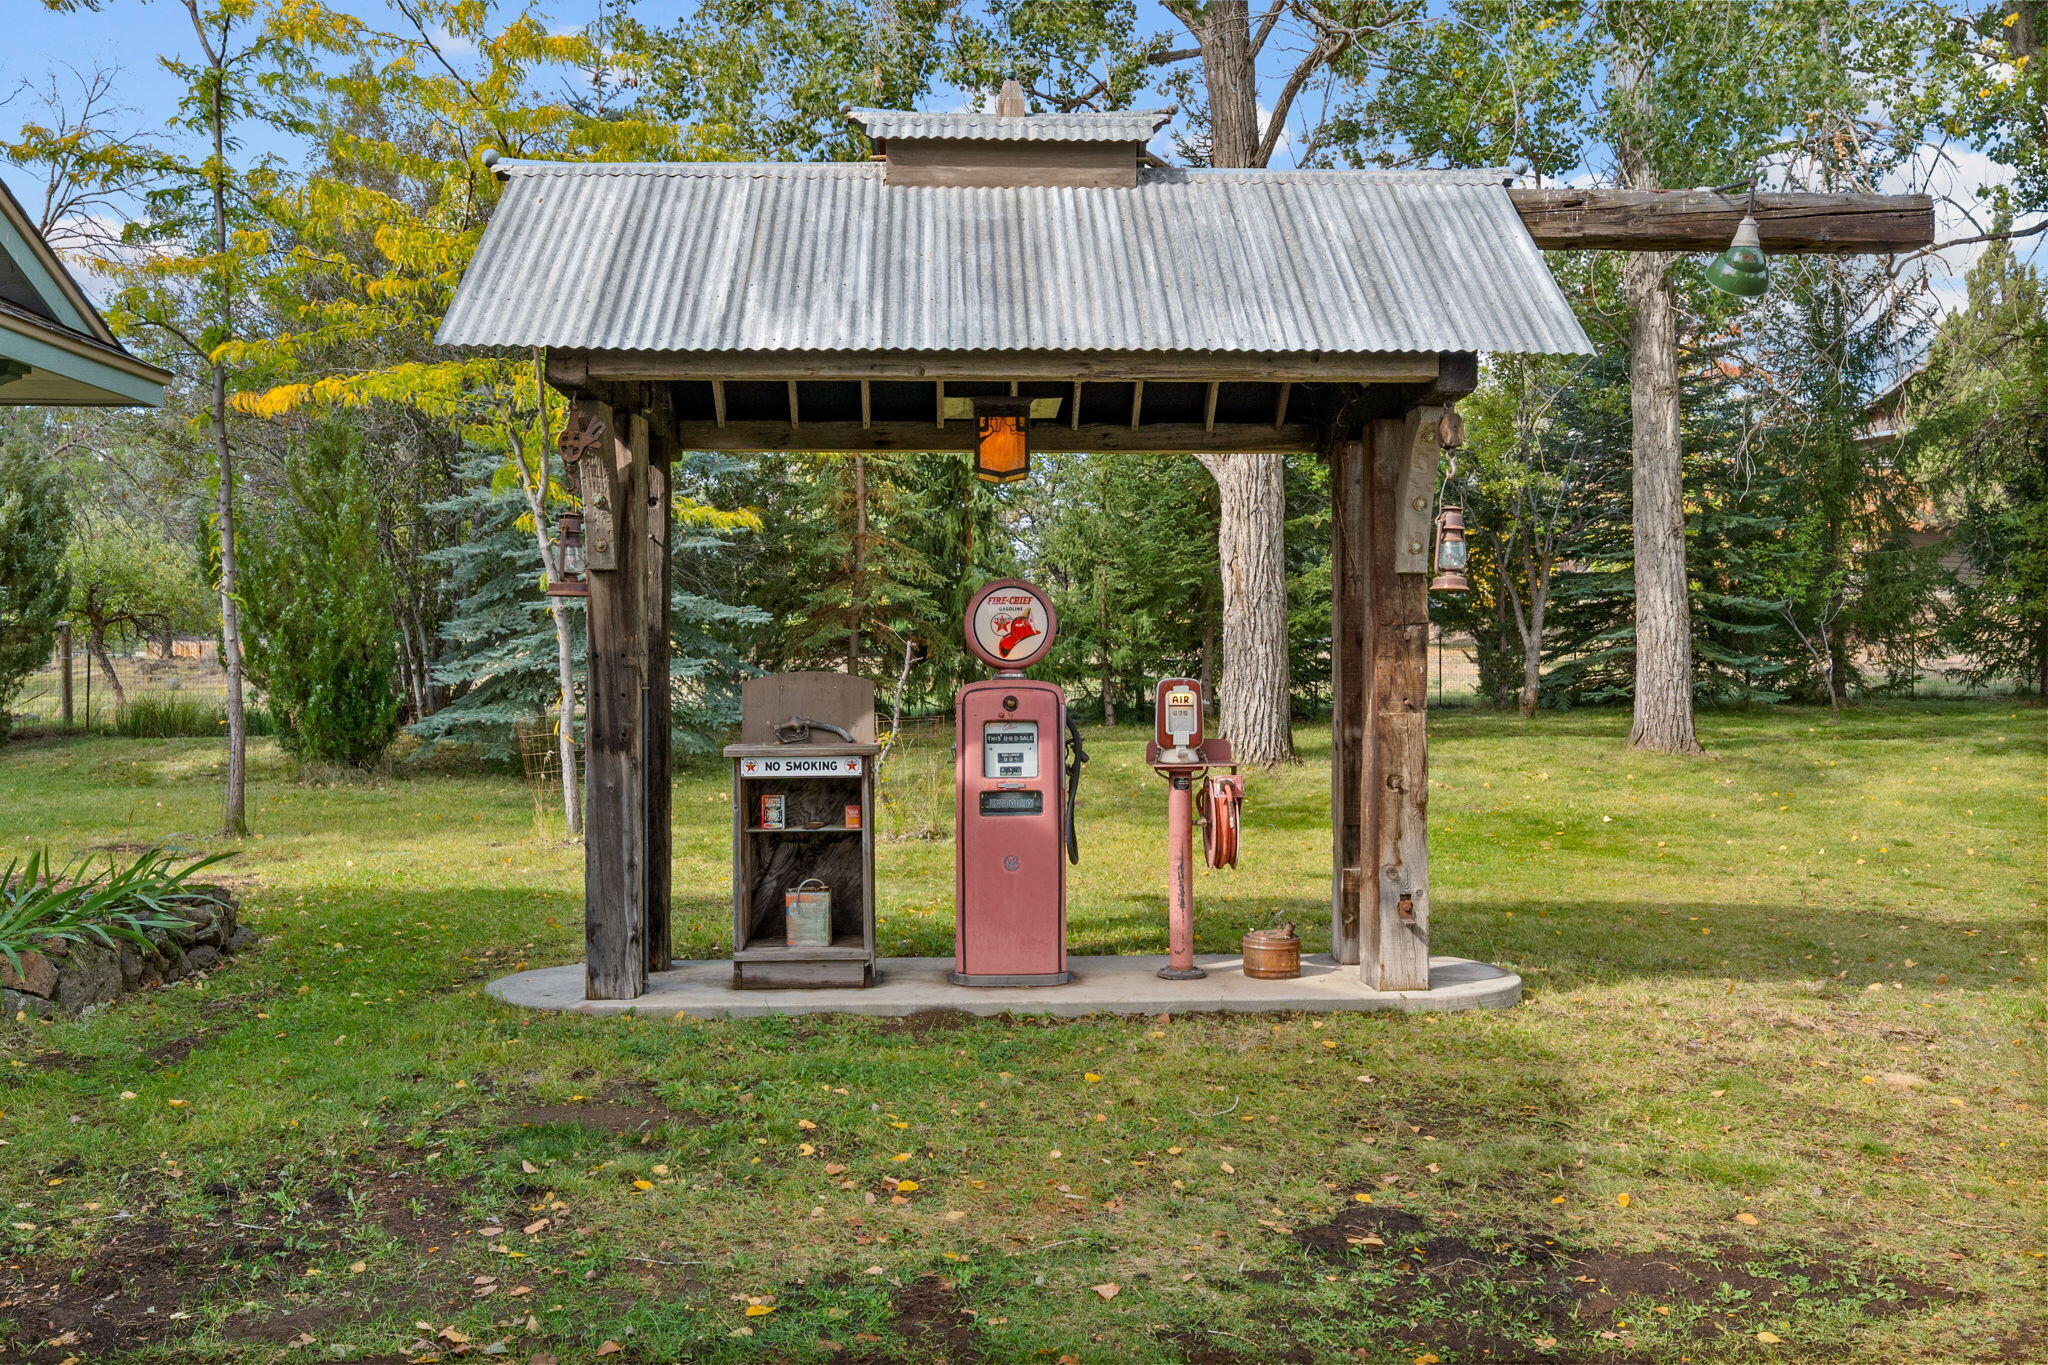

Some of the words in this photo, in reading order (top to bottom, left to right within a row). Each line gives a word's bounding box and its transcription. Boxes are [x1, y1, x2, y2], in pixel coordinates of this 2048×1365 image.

[987, 596, 1034, 605] FIRE-CHIEF
[1172, 696, 1190, 704] AIR
[765, 761, 781, 771] NO
[785, 761, 838, 771] SMOKING
